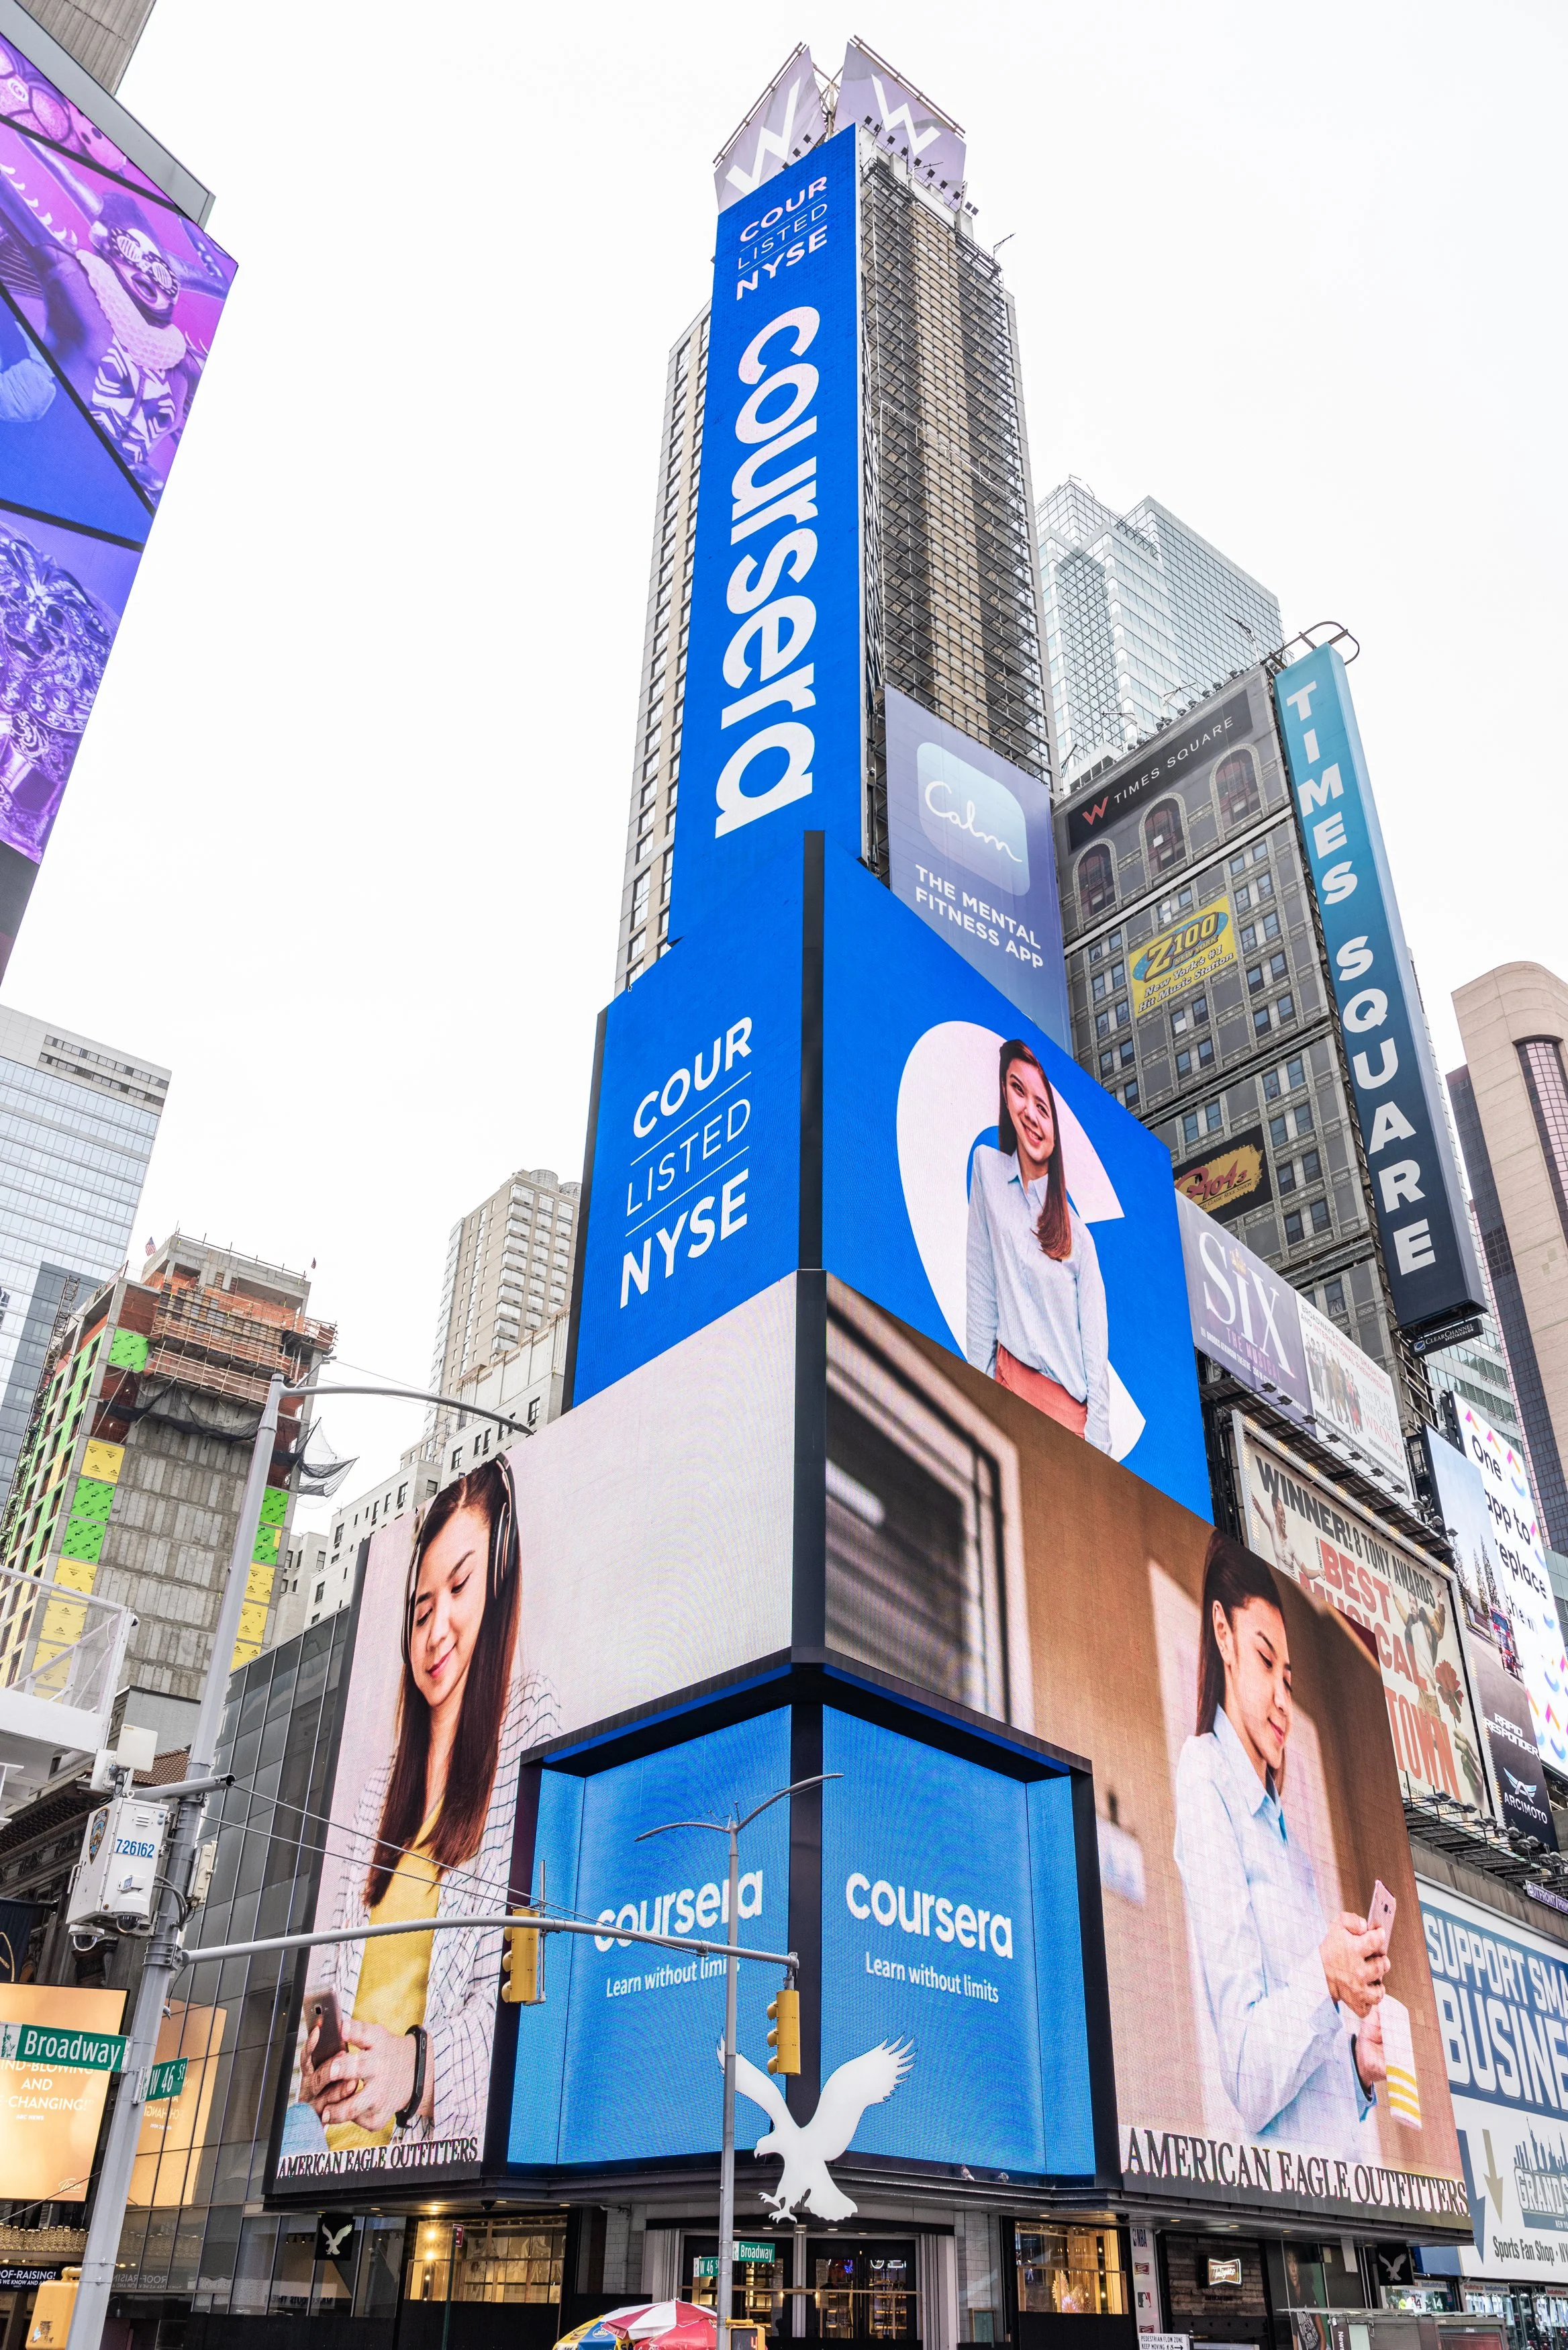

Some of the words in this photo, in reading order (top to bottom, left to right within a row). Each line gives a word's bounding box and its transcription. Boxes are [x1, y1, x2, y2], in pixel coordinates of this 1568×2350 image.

[725, 77, 801, 195] W
[871, 74, 941, 156] W
[739, 203, 827, 270] LISTED
[740, 176, 827, 242] COUR
[736, 225, 827, 300] NYSE
[714, 306, 820, 839] coursera
[1082, 796, 1109, 825] W
[1114, 767, 1160, 804] TIMES
[1167, 716, 1233, 768] SQUARE
[924, 780, 1023, 863] Calm
[916, 864, 956, 900] THE
[962, 891, 1041, 949] MENTAL
[916, 886, 999, 946] FITNESS
[1005, 939, 1044, 969] APP
[1143, 911, 1220, 983] Z100
[1144, 977, 1171, 998] New
[1173, 957, 1206, 981] York's
[1208, 944, 1223, 961] #1
[1194, 934, 1220, 955] YORK
[1138, 996, 1156, 1013] Hit
[1157, 977, 1192, 1002] Music
[1194, 952, 1234, 981] Station
[1287, 680, 1359, 905] TIMES
[1336, 935, 1436, 1275] SQUARE
[633, 1017, 752, 1139] COUR
[626, 1098, 751, 1217] LISTED
[620, 1168, 749, 1309] NYSE
[1199, 1231, 1295, 1379] SIX
[1301, 1313, 1312, 1329] AND
[1444, 1328, 1475, 1342] SPECTACOLOR
[1226, 1326, 1243, 1353] THE
[1245, 1342, 1282, 1384] MUSICAL
[1363, 1410, 1403, 1461] WRONG
[1377, 1409, 1400, 1439] GOES
[1472, 1434, 1503, 1482] One
[1255, 1454, 1355, 1553] WINNER!
[1353, 1526, 1363, 1558] 8
[1361, 1532, 1391, 1579] TONY
[1391, 1554, 1436, 1609] AWARDS
[1513, 1507, 1531, 1546] to
[1320, 1538, 1391, 1624] BEST
[1496, 1538, 1547, 1600] eplace
[1482, 1717, 1540, 1761] RESPONDER
[1493, 1712, 1523, 1738] RAPID
[1504, 1792, 1548, 1825] ARCIMOTO
[845, 1872, 1013, 1959] coursera
[606, 1975, 641, 1997] Learn
[644, 1961, 697, 1990] without
[865, 1951, 905, 1981] Learn
[908, 1963, 962, 1994] without
[963, 1974, 999, 2004] limits
[1422, 1912, 1529, 2006] SUPPORT
[23, 2030, 121, 2071] Broadway
[1432, 1977, 1568, 2112] BUSINE
[21, 2078, 53, 2091] AND
[149, 2069, 161, 2096] W
[161, 2065, 176, 2093] 46
[177, 2063, 186, 2081] St
[276, 2150, 344, 2179] AMERICAN
[344, 2146, 389, 2173] EAGLE
[390, 2136, 479, 2169] OUTFITTERS
[1125, 2127, 1273, 2191] AMERICAN
[1277, 2151, 1352, 2200] EAGLE
[1354, 2163, 1471, 2217] OUTFITTERS
[700, 2260, 705, 2275] W
[706, 2259, 714, 2275] 46
[740, 2245, 773, 2263] Broadway
[1137, 2228, 1147, 2248] NBA
[1493, 2235, 1520, 2263] Sports
[1519, 2239, 1535, 2261] Fan
[1534, 2240, 1555, 2267] Shop
[1141, 2335, 1163, 2343] PEDESTRIAN
